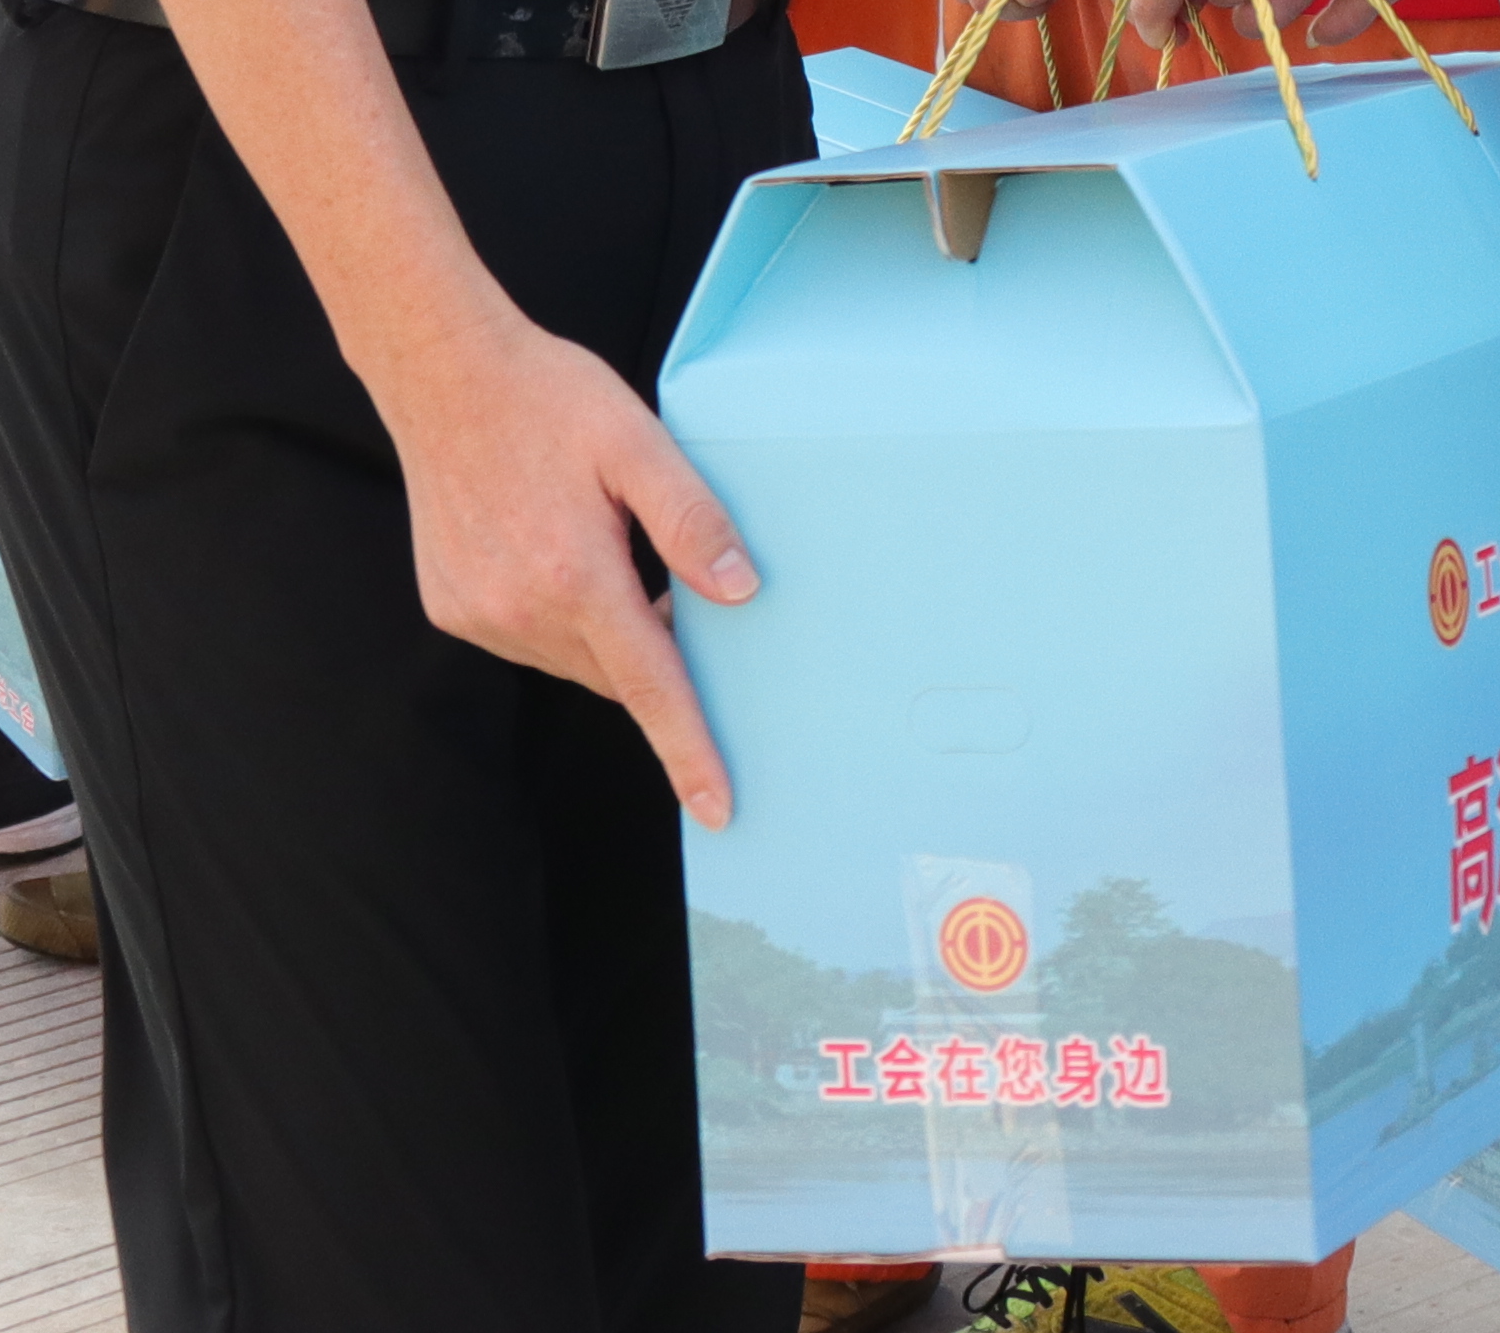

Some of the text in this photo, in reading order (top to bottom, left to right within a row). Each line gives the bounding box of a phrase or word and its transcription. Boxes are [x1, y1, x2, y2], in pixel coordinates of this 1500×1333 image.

[819, 1035, 1171, 1108] 工会在您身边
